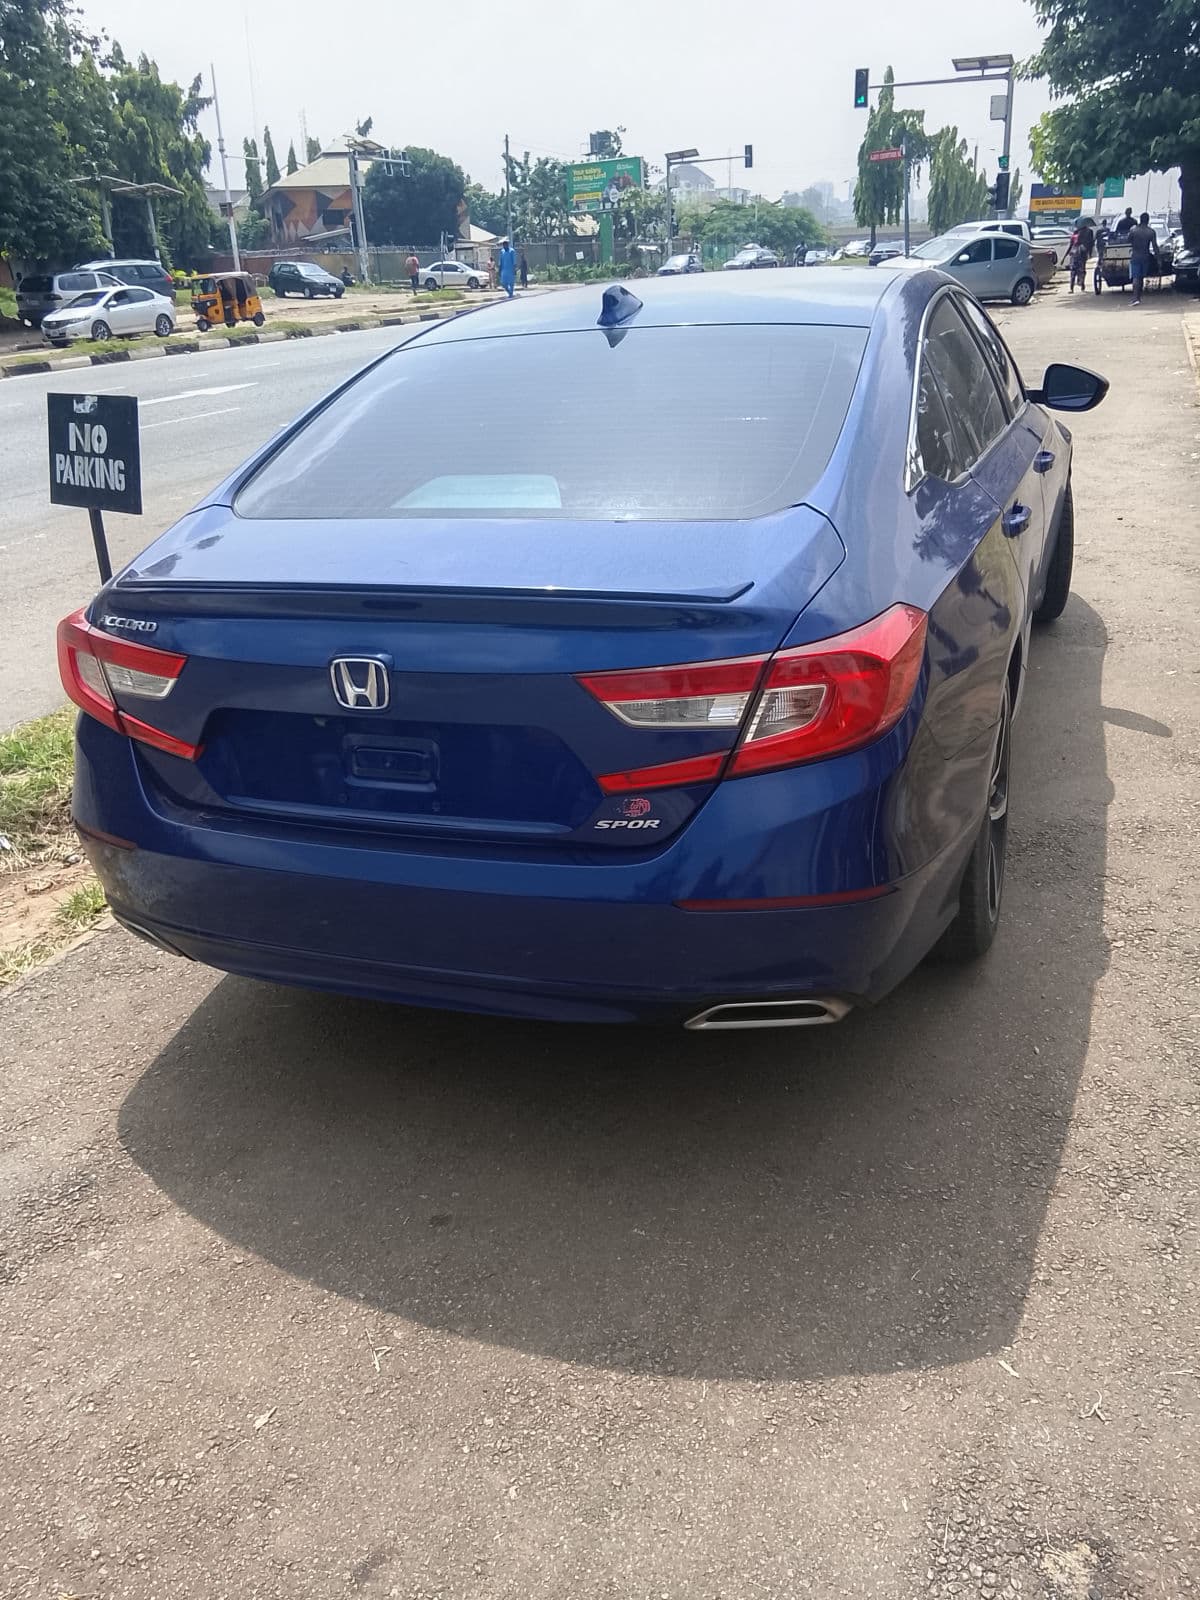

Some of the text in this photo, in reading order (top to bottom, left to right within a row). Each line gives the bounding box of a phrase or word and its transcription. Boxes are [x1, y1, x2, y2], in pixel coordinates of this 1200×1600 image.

[69, 423, 107, 454] NO
[56, 453, 125, 491] PARKING
[594, 819, 661, 829] SPOR
